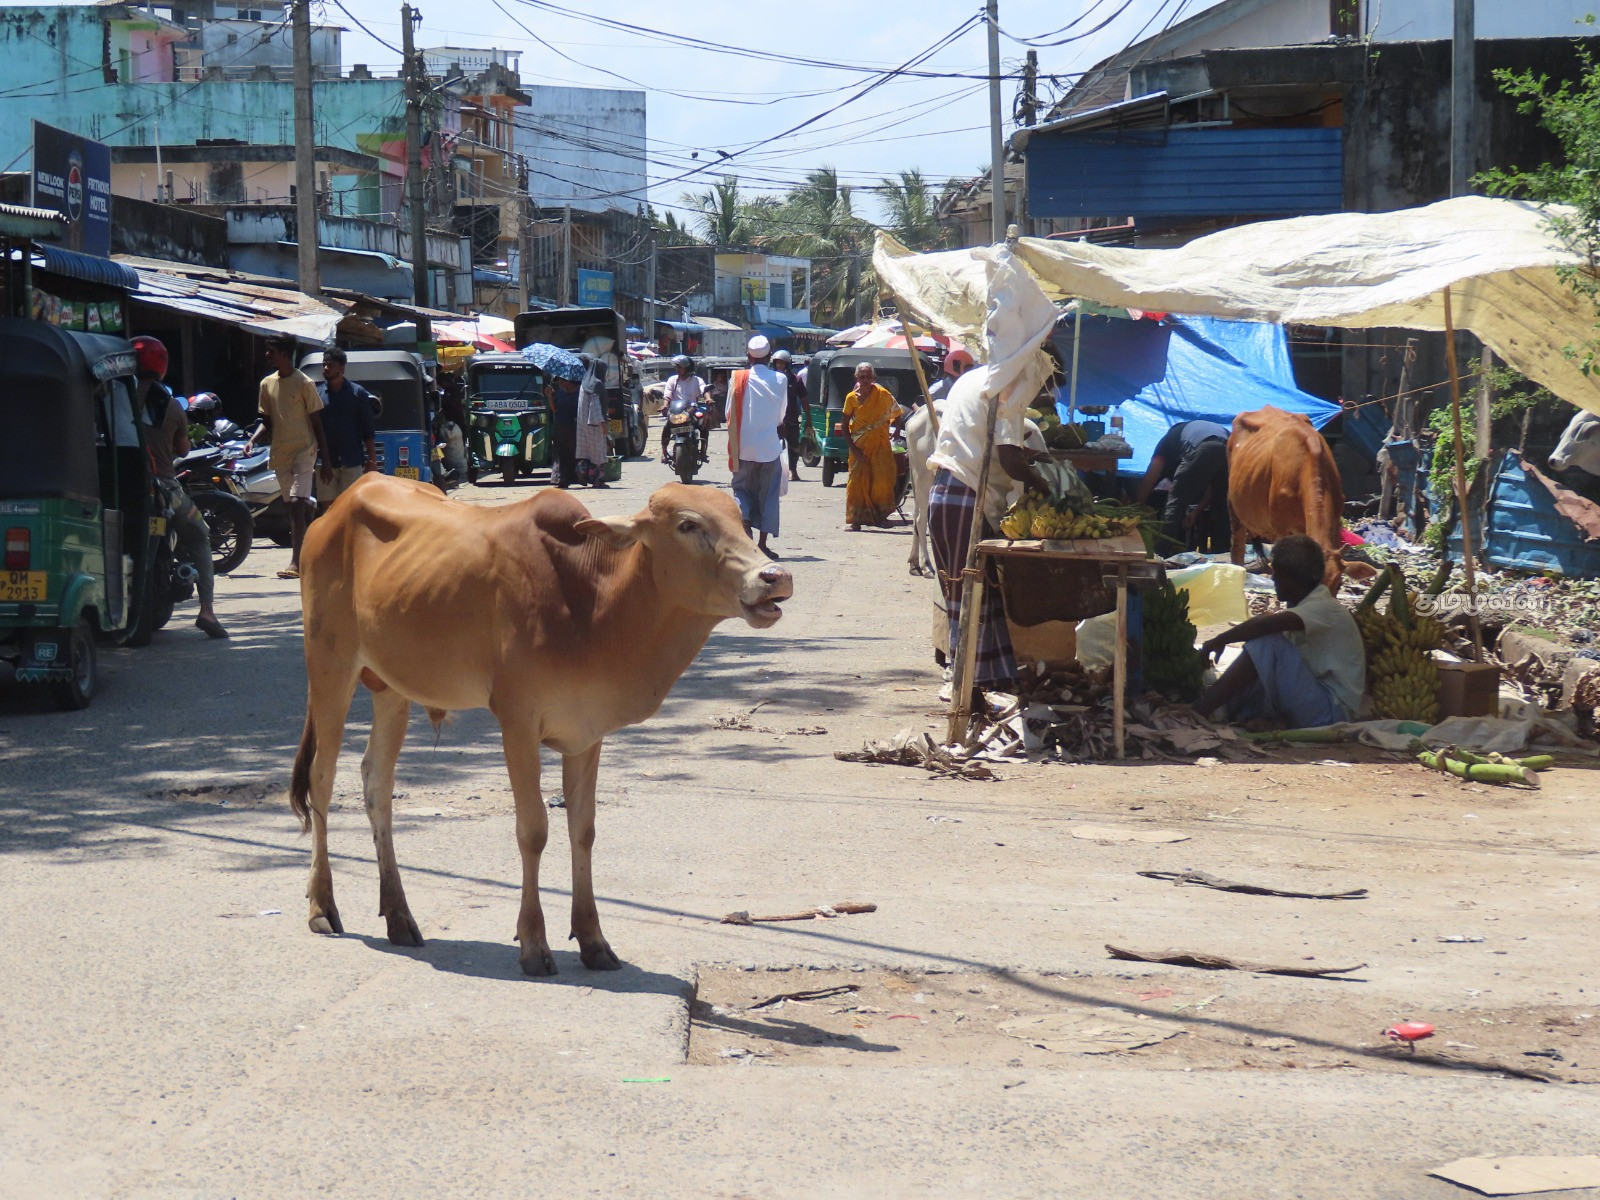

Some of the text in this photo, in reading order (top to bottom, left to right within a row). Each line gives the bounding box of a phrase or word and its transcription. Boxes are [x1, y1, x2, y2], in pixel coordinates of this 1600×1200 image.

[37, 171, 64, 188] NEW LOOK
[90, 195, 107, 213] HOTEL
[494, 401, 527, 409] ABA 0503
[7, 586, 39, 600] 2913
